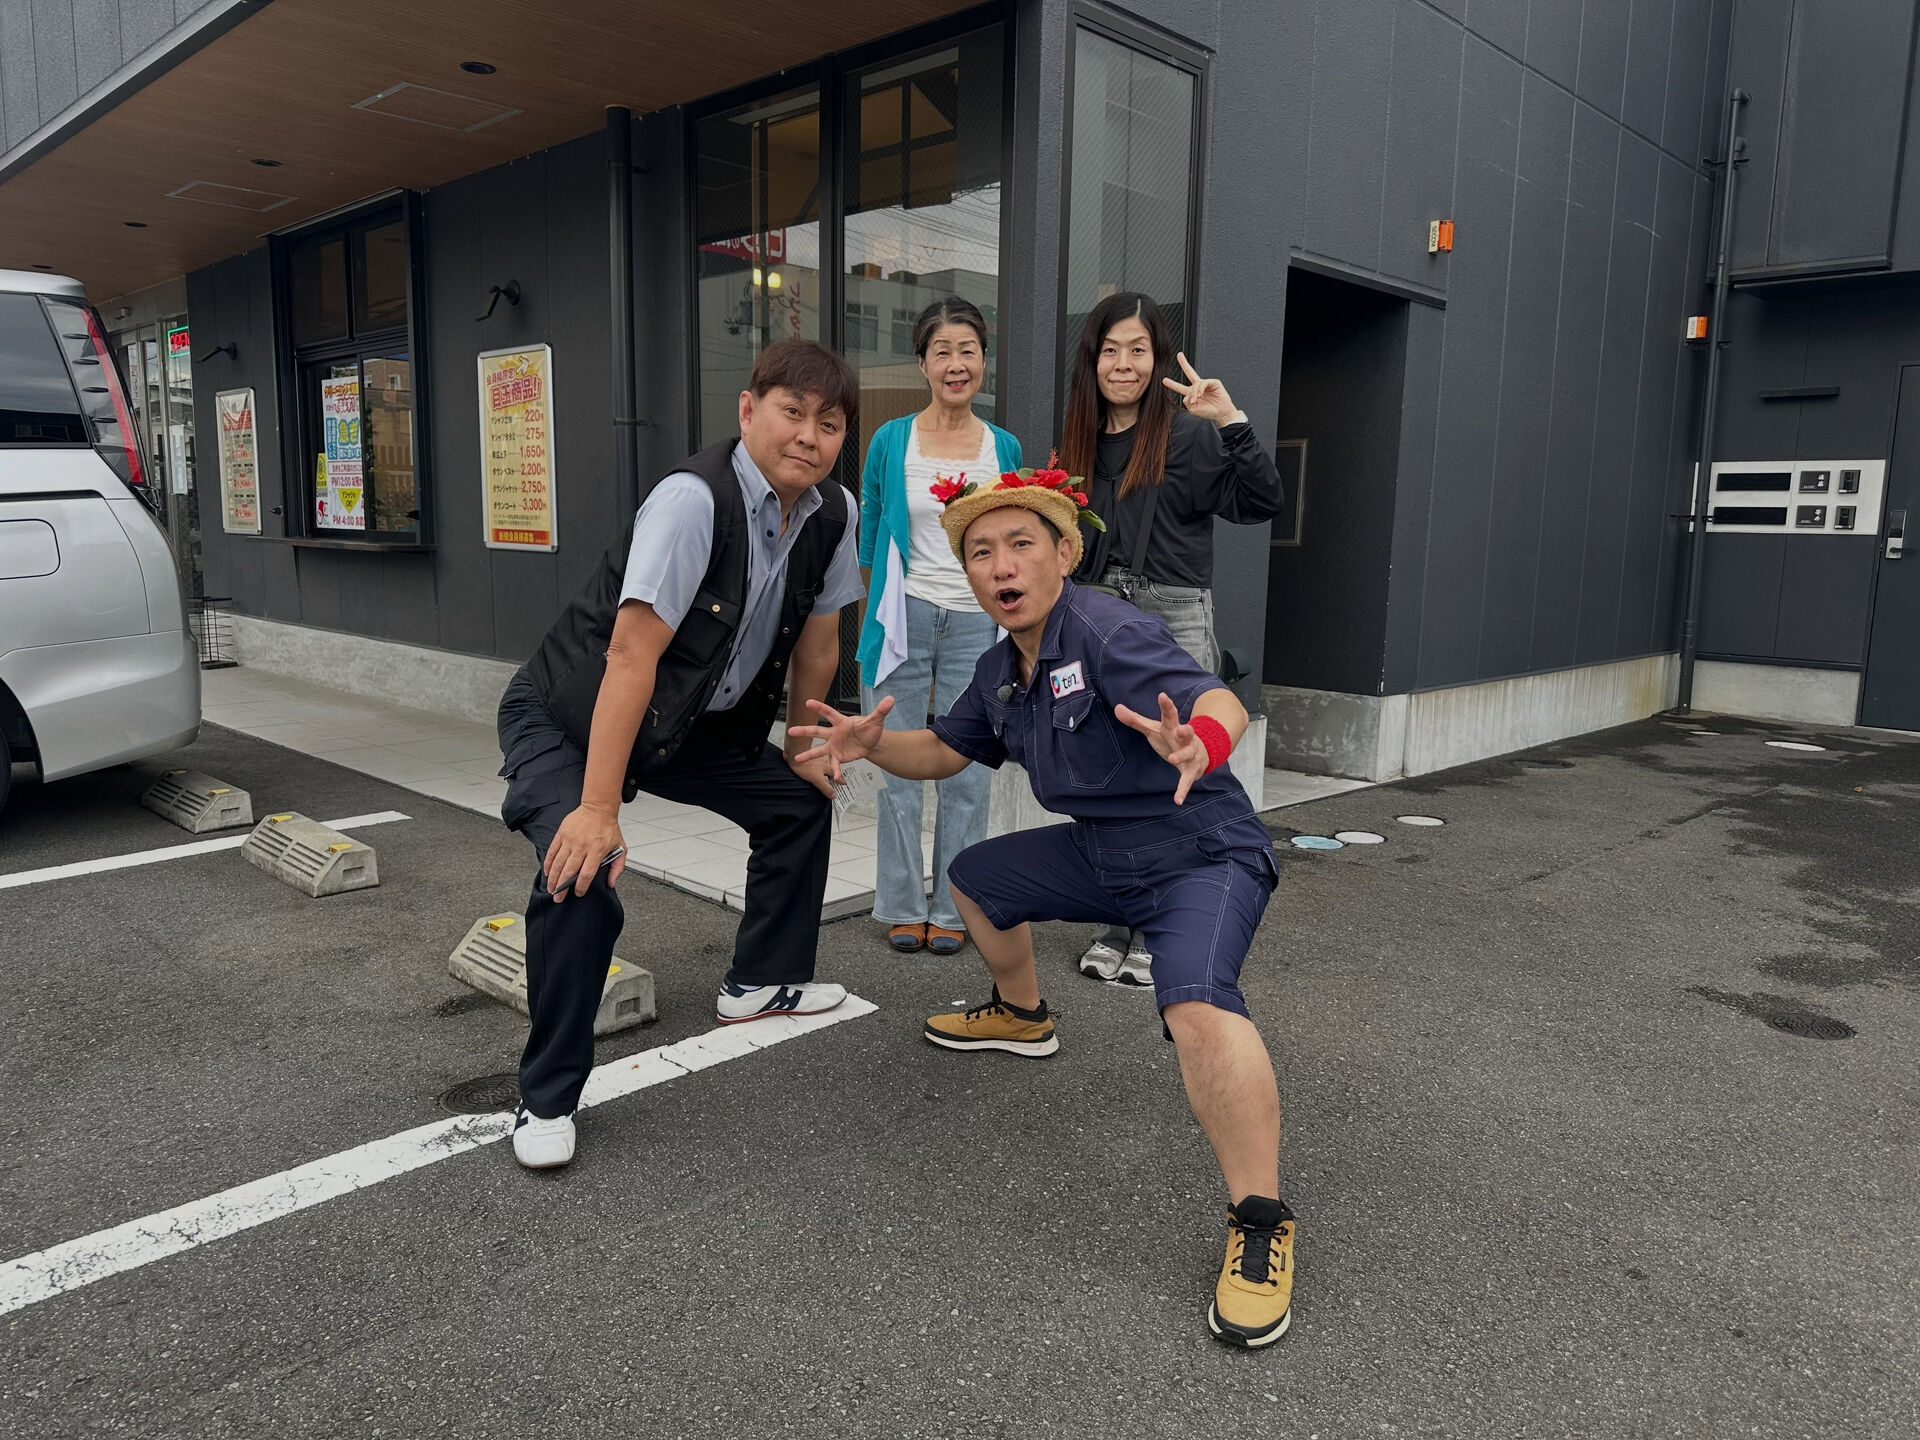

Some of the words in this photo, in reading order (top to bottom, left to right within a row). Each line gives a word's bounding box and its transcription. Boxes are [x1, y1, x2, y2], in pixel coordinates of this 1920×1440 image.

[520, 445, 545, 459] 1,650円
[521, 463, 545, 477] 2,200円
[521, 481, 546, 494] 2,750円
[493, 501, 516, 510] ダウンコート
[522, 498, 547, 511] 3,300円
